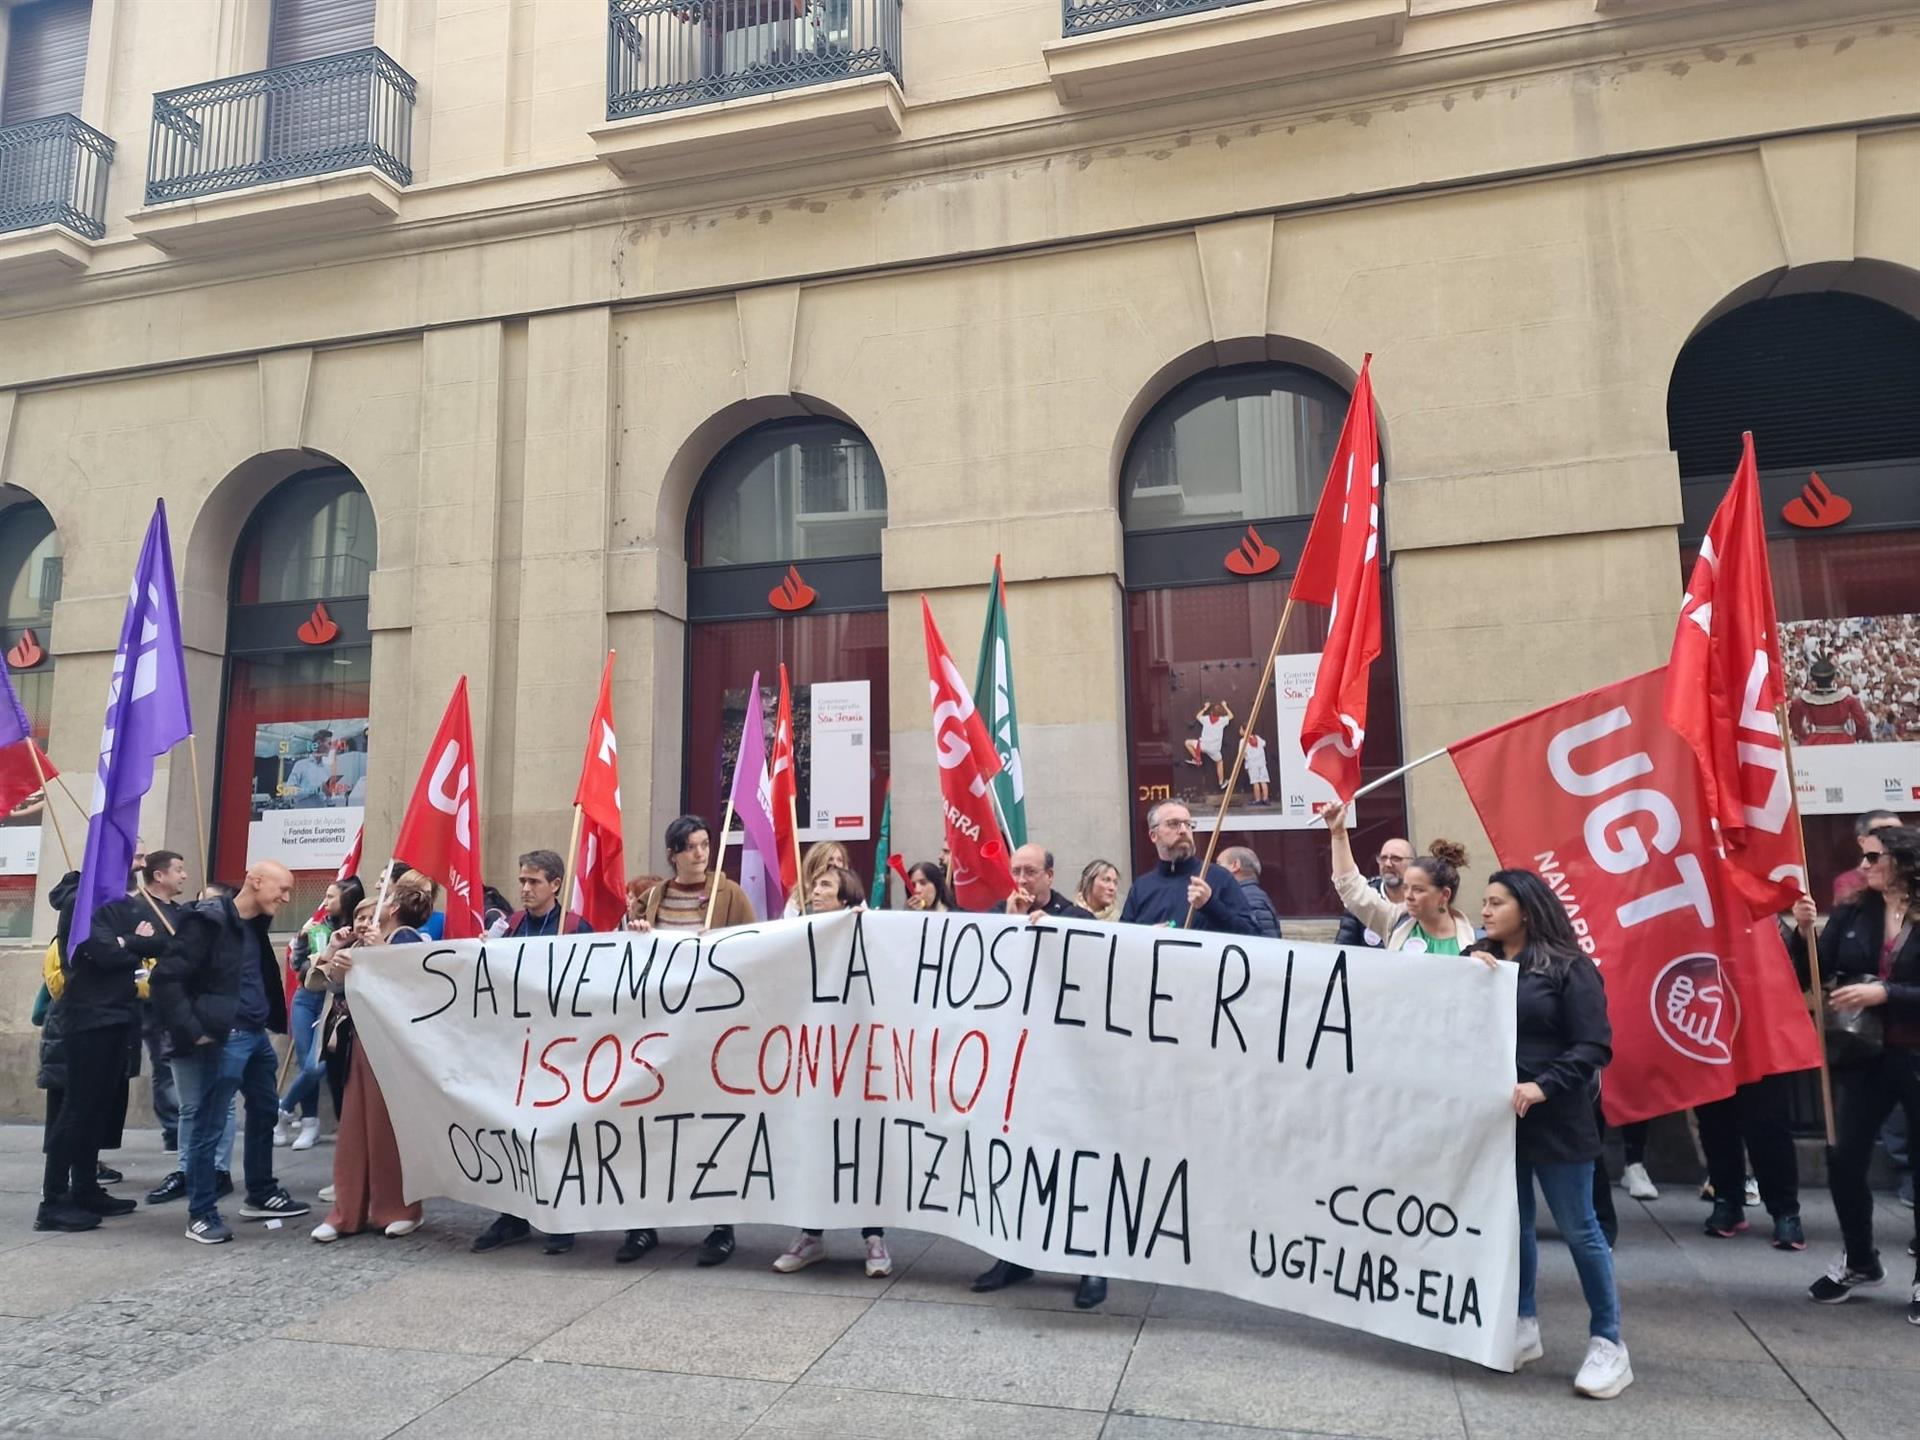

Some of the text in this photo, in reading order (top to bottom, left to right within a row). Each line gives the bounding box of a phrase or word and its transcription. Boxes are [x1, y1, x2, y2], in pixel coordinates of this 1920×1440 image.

[289, 826, 312, 836] Fondos
[314, 826, 346, 836] Europeos
[1290, 794, 1305, 804] DN
[1547, 705, 1715, 928] UGT
[1885, 778, 1902, 788] DN
[281, 835, 346, 845] Next GenerationEU
[411, 912, 1355, 1075] SALVEMOS LA HOSTELERIA
[710, 1022, 1029, 1134] CONVENIO!
[447, 1111, 1192, 1265] OSTALARITZA HITZARMENA
[1249, 1229, 1483, 1328] UGT-LAB-ELA
